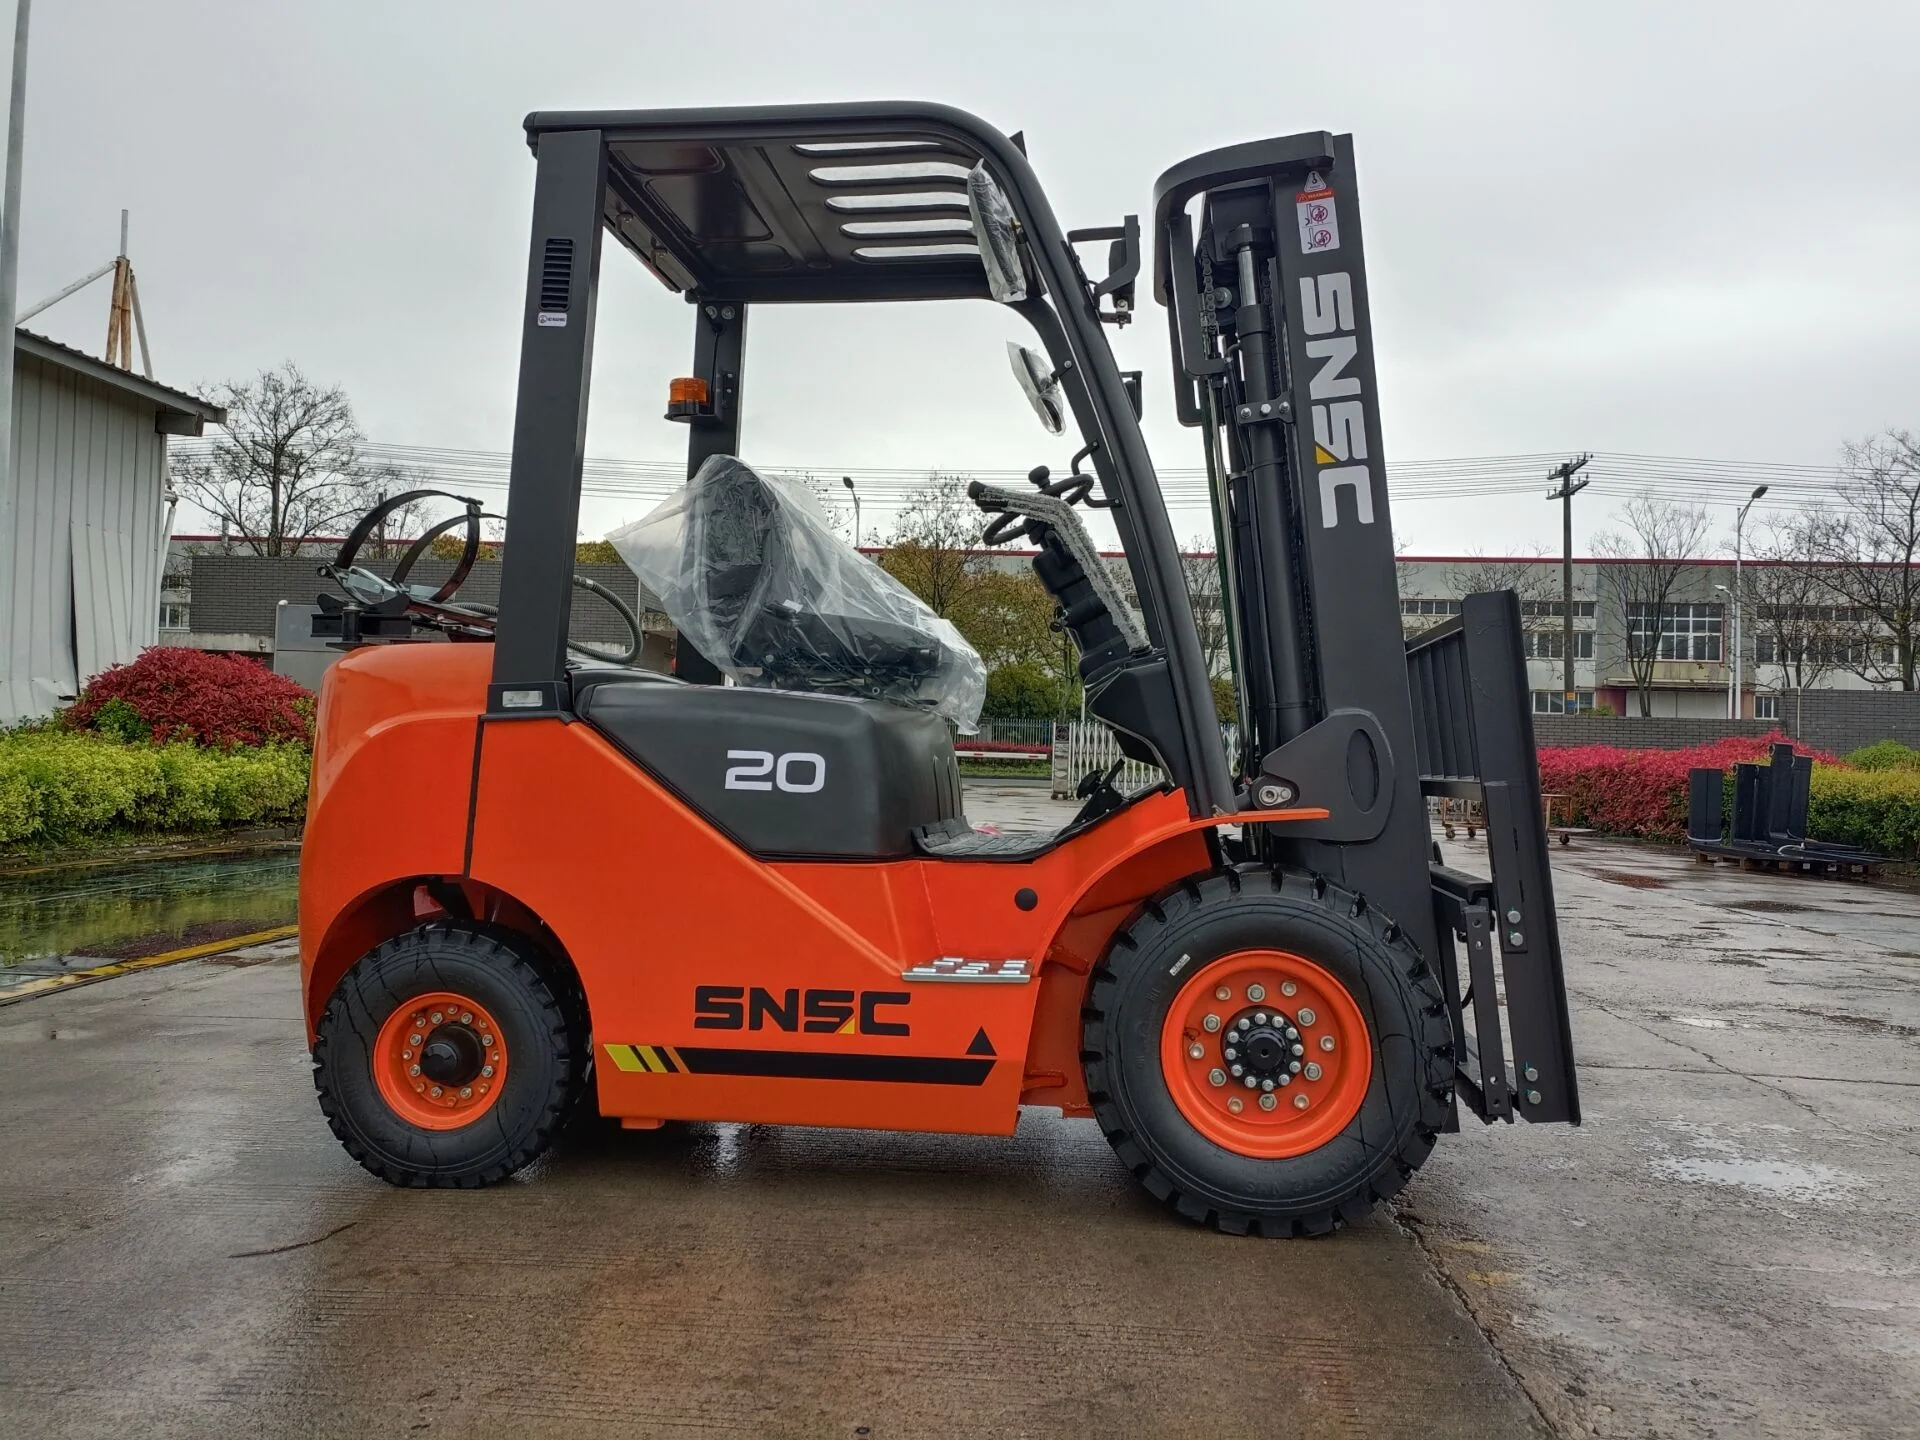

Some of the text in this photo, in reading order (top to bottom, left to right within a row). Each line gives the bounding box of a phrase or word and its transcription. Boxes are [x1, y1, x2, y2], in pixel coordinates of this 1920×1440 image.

[1299, 272, 1374, 528] SNSC
[725, 750, 825, 793] 20
[695, 986, 910, 1036] SNSC
